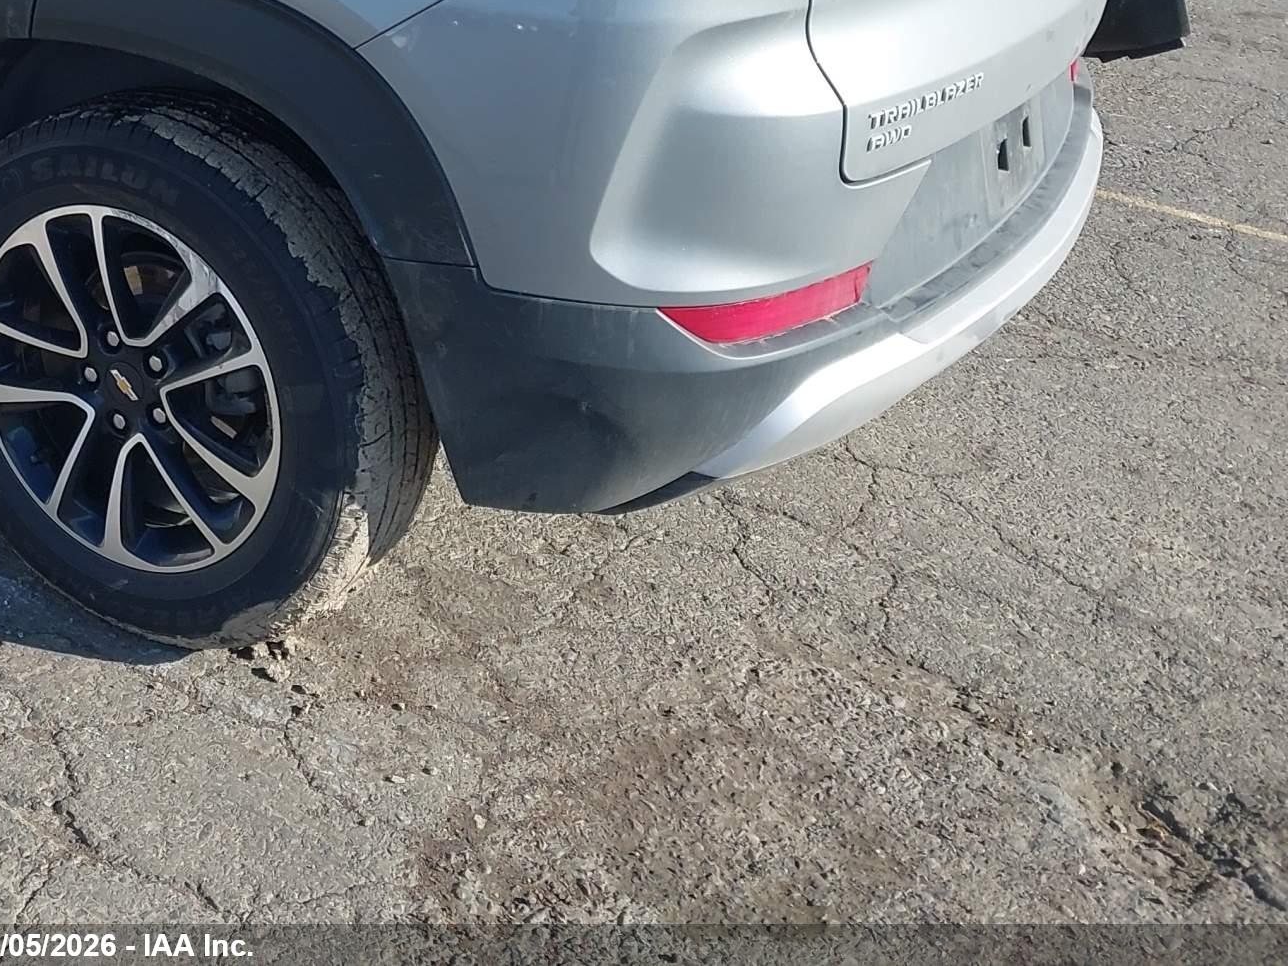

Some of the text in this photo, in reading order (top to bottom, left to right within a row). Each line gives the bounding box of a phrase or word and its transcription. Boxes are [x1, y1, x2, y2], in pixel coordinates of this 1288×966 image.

[868, 72, 985, 130] TRAILBLAZER
[866, 124, 912, 153] AWD
[31, 153, 180, 207] SAILUN
